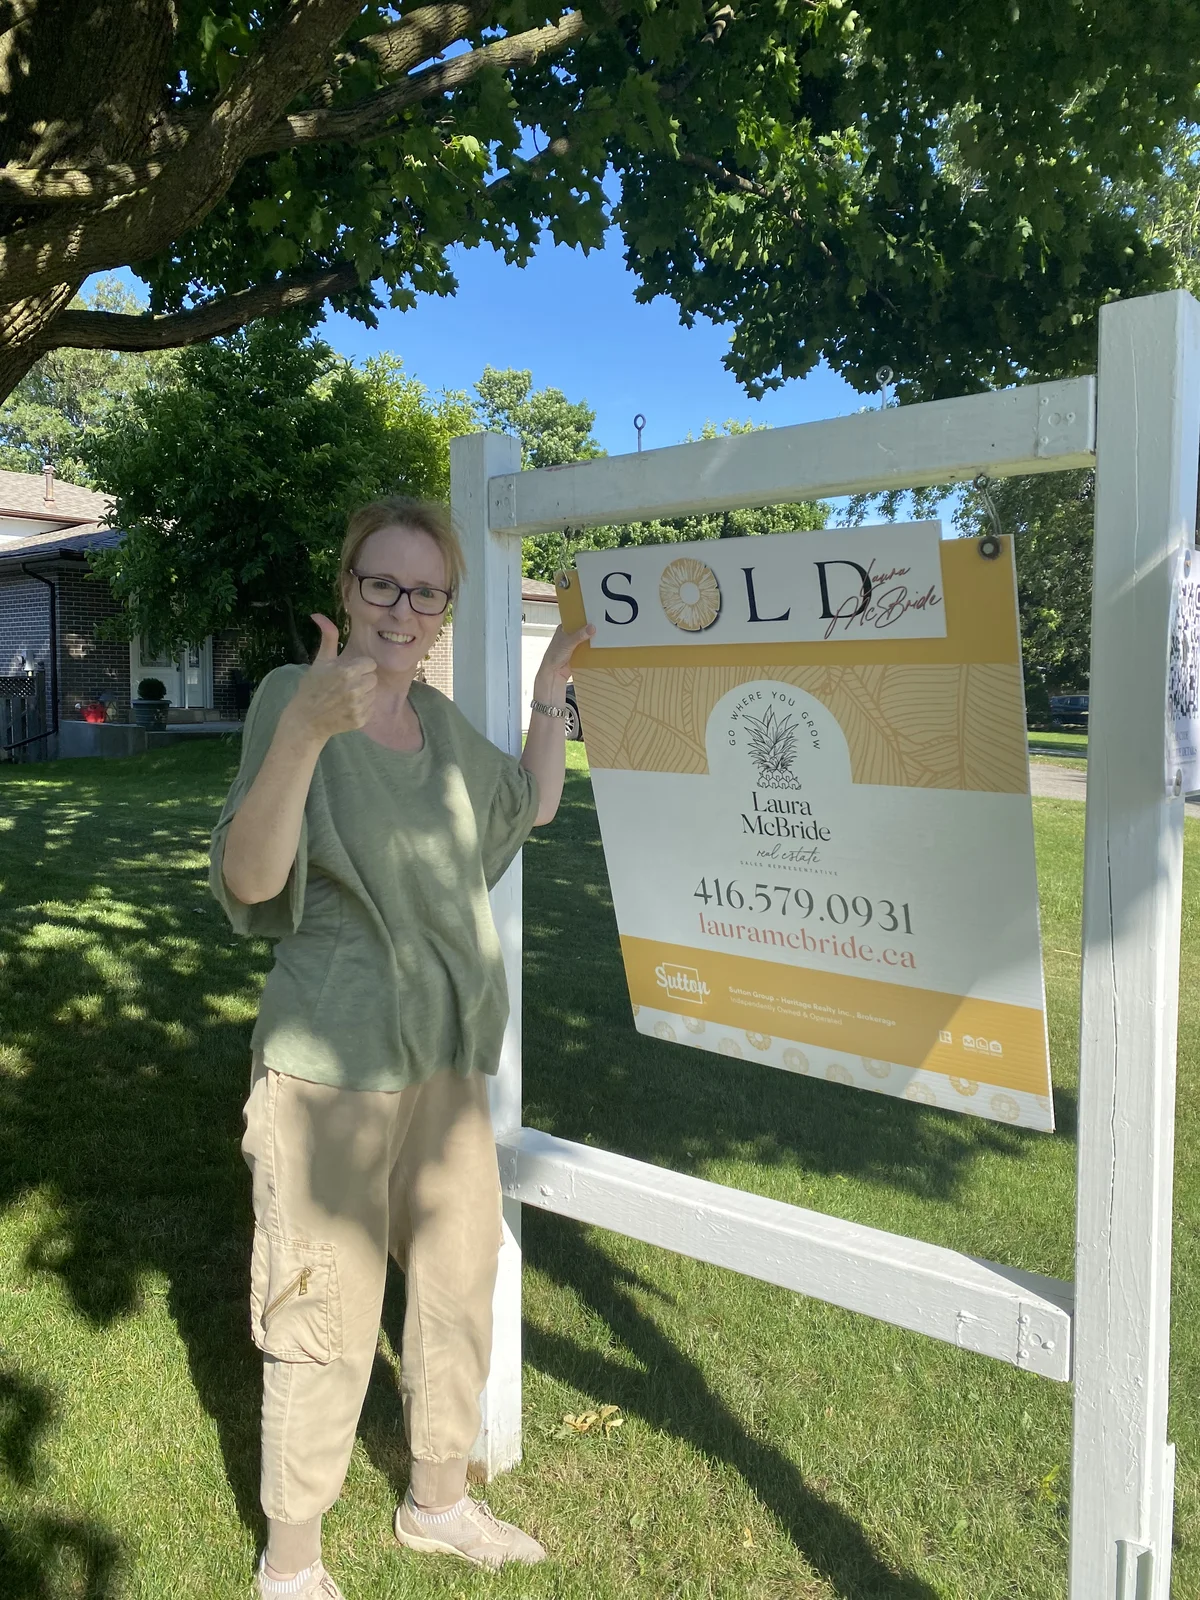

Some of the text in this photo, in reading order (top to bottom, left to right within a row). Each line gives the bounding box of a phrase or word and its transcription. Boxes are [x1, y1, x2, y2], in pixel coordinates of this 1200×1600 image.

[600, 556, 873, 633] SOLD
[859, 558, 911, 598] Laura
[824, 585, 942, 640] McBride
[728, 691, 820, 750] GO WHERE YOU GROW
[752, 791, 812, 815] Laura
[740, 814, 831, 842] McBride
[756, 843, 821, 864] real estate
[767, 863, 838, 876] REPRESENTATIVE
[693, 876, 915, 936] 416.579.0931
[698, 912, 917, 969] lauramcbride.ca
[655, 966, 710, 995] Sutton
[728, 986, 752, 997] Sutton
[752, 991, 774, 1003] Group
[781, 997, 812, 1009] Heritage
[812, 1003, 836, 1015] Realty
[856, 1012, 896, 1027] Brokerage
[730, 996, 775, 1013] Independently
[777, 1006, 801, 1017] Owned
[809, 1013, 843, 1026] Operated
